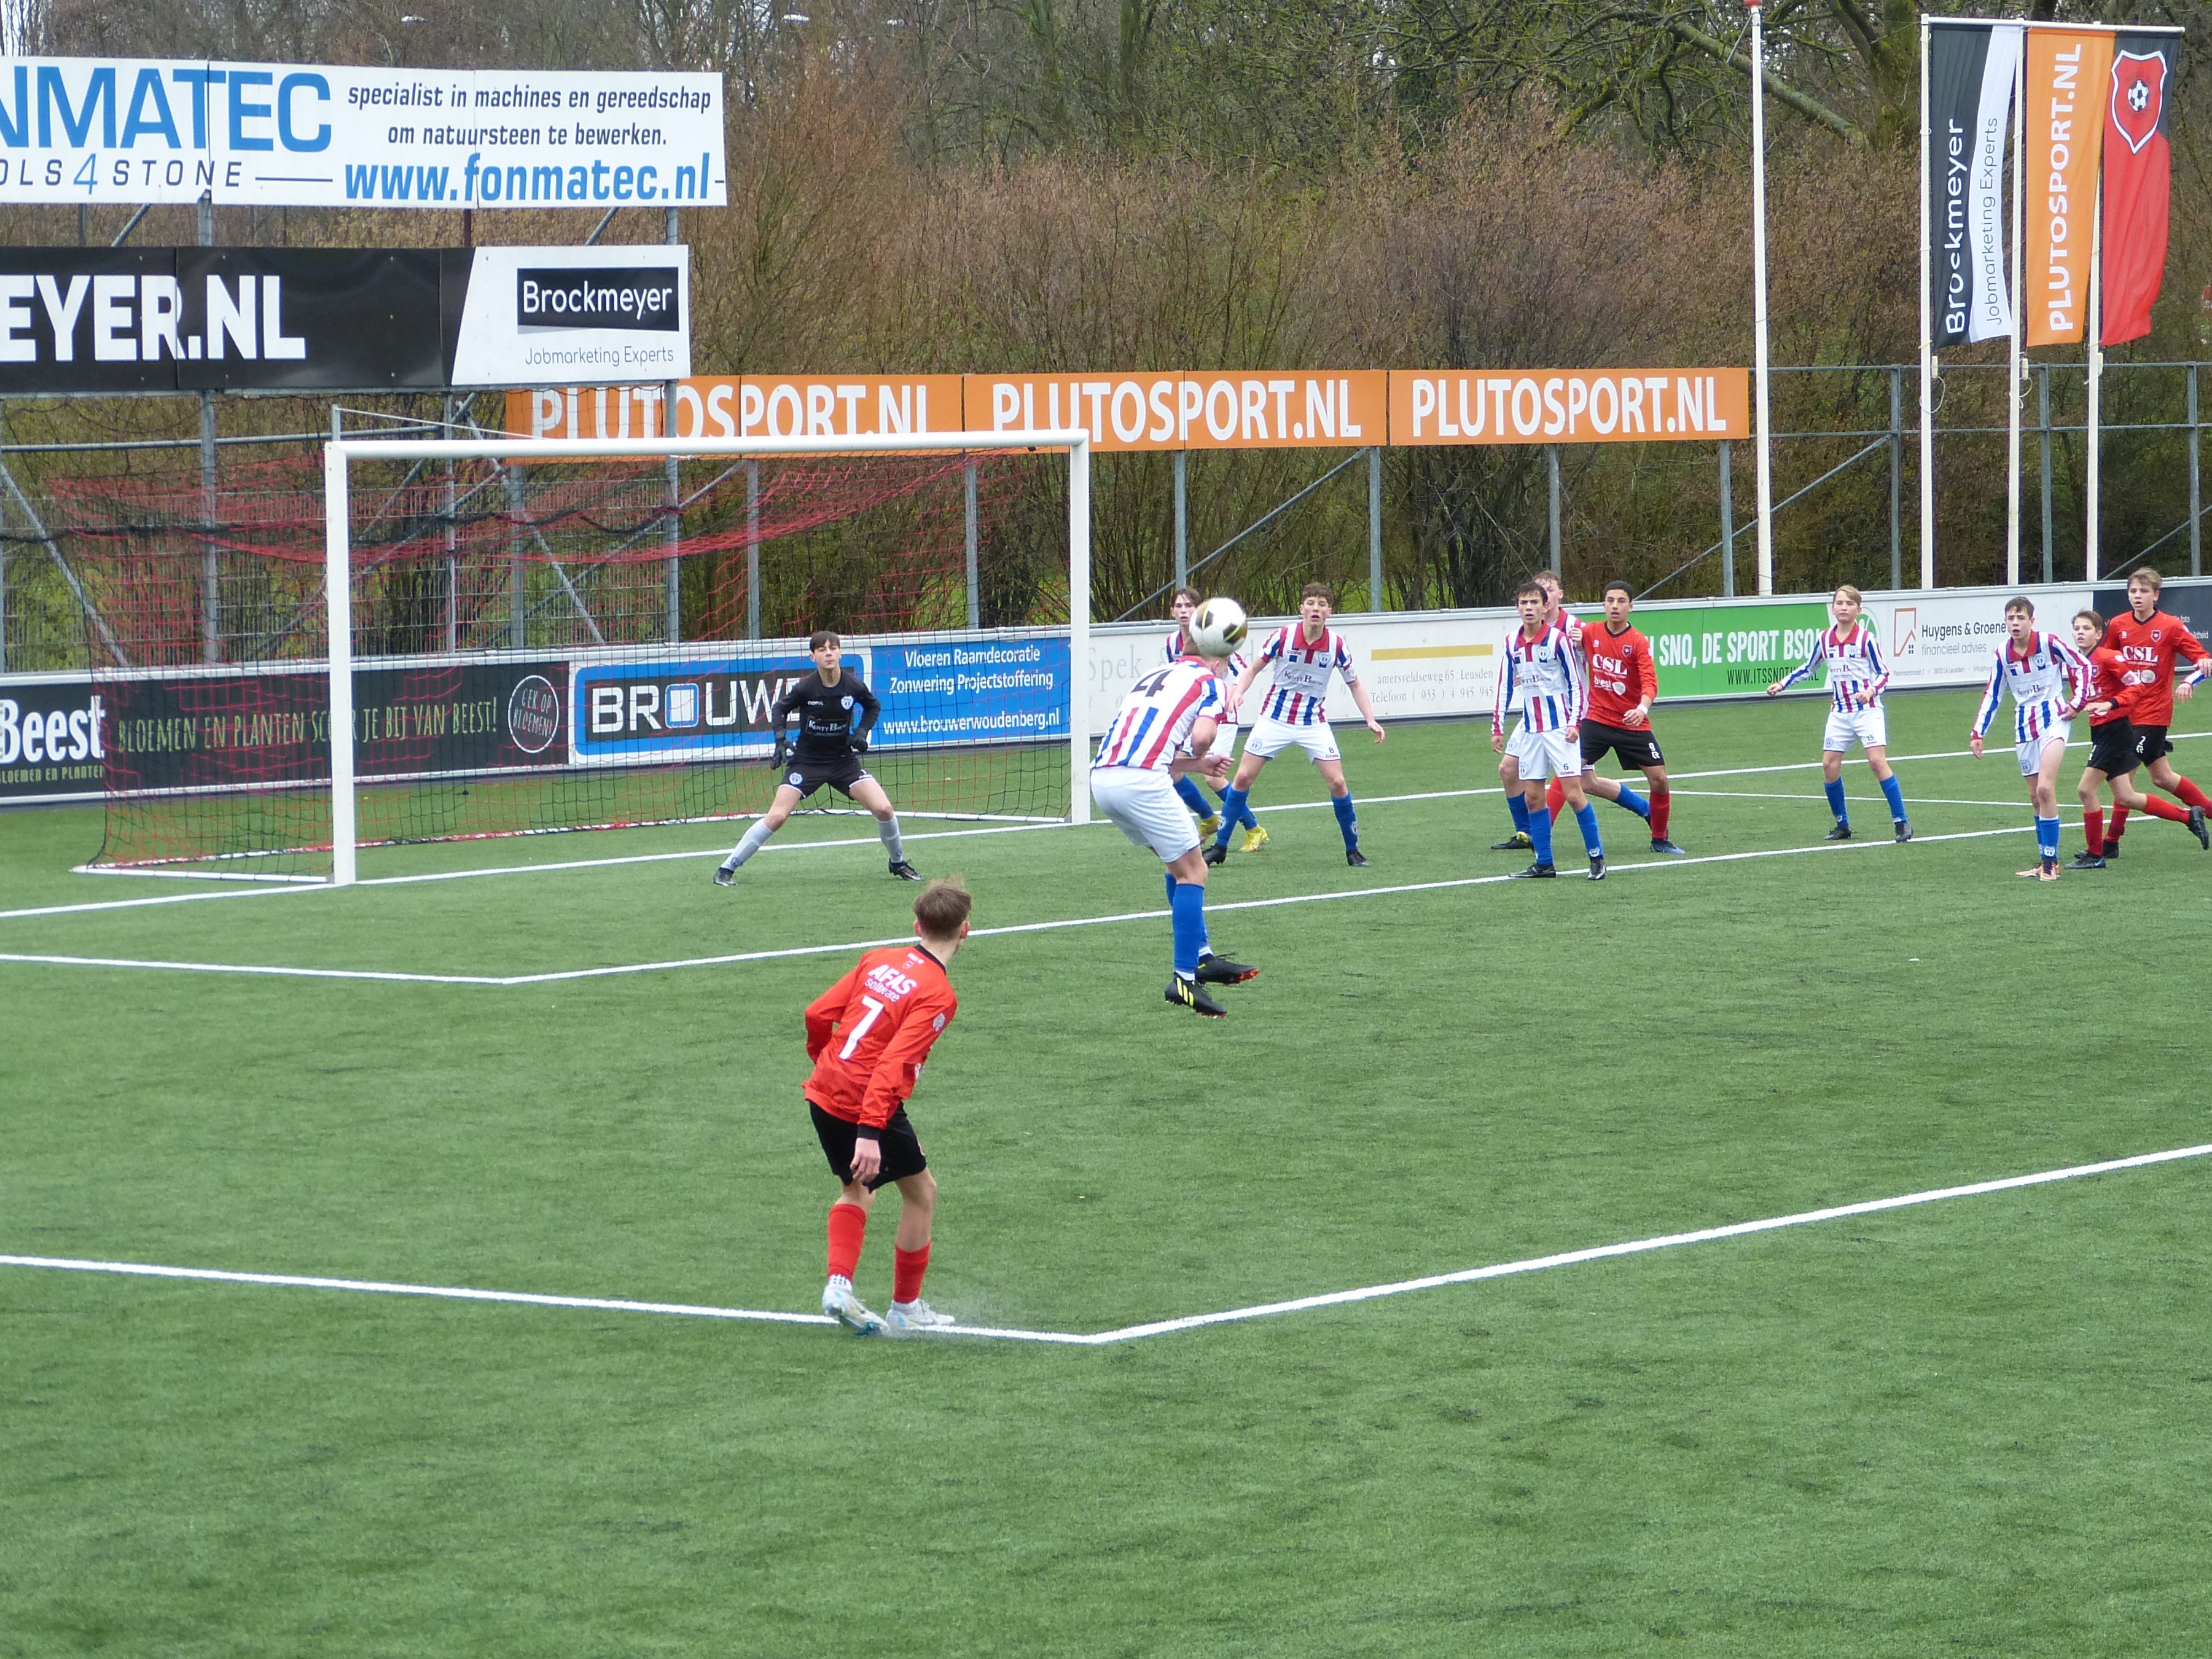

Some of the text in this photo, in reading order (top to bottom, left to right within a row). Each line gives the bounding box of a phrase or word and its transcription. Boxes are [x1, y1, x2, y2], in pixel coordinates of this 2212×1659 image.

[348, 82, 711, 113] specialist in machines en gereedschap
[388, 123, 667, 146] om natuursteen te bewerken.
[345, 152, 710, 201] www.fonmatec.nl
[2049, 44, 2082, 330] PLUTOSPORT.NL
[1944, 118, 1968, 334] Brockmeyer
[1980, 117, 2001, 325] Jobmarketing Experts
[523, 281, 672, 319] Brockmeyer
[0, 274, 306, 362] EYER.NL
[525, 346, 674, 367] Jobmarketing Experts
[993, 379, 1361, 442] PLUTOSPORT.NL
[1412, 376, 1727, 437] PLUTOSPORT.NL
[1921, 624, 1962, 641] Huygens
[1964, 622, 1971, 635] &
[904, 644, 1041, 668] Vloeren Raamdecoratie
[1659, 633, 1697, 669] SNO,
[1702, 632, 1723, 665] DE
[1727, 630, 1780, 663] SPORT
[1921, 642, 1987, 656] financieel advies
[2123, 645, 2159, 663] CSL
[1460, 668, 1493, 681] Leusden
[1592, 654, 1628, 676] CSL
[889, 669, 1053, 695] Zonwering Projectstoffering
[1130, 668, 1174, 697] 4
[1370, 690, 1407, 703] Telefoon
[1460, 686, 1474, 699] 945
[1479, 685, 1494, 698] 945
[541, 693, 552, 714] OP
[0, 695, 105, 764] Beest
[119, 717, 197, 754] BLOEMEN
[205, 716, 226, 749] EN
[234, 711, 304, 748] PLANTEN
[363, 708, 378, 743] JE
[386, 706, 407, 741] BIJ
[413, 704, 445, 736] VAN
[452, 696, 497, 735] BEEST!
[883, 707, 1060, 735] www.brouwerwoudenberg.nl
[1648, 742, 1656, 751] 9
[2138, 735, 2146, 746] 2
[0, 768, 41, 784] LOEMEN
[45, 768, 58, 781] EN
[864, 978, 900, 1002] software
[867, 964, 917, 995] AFAS
[838, 994, 885, 1060] 7
